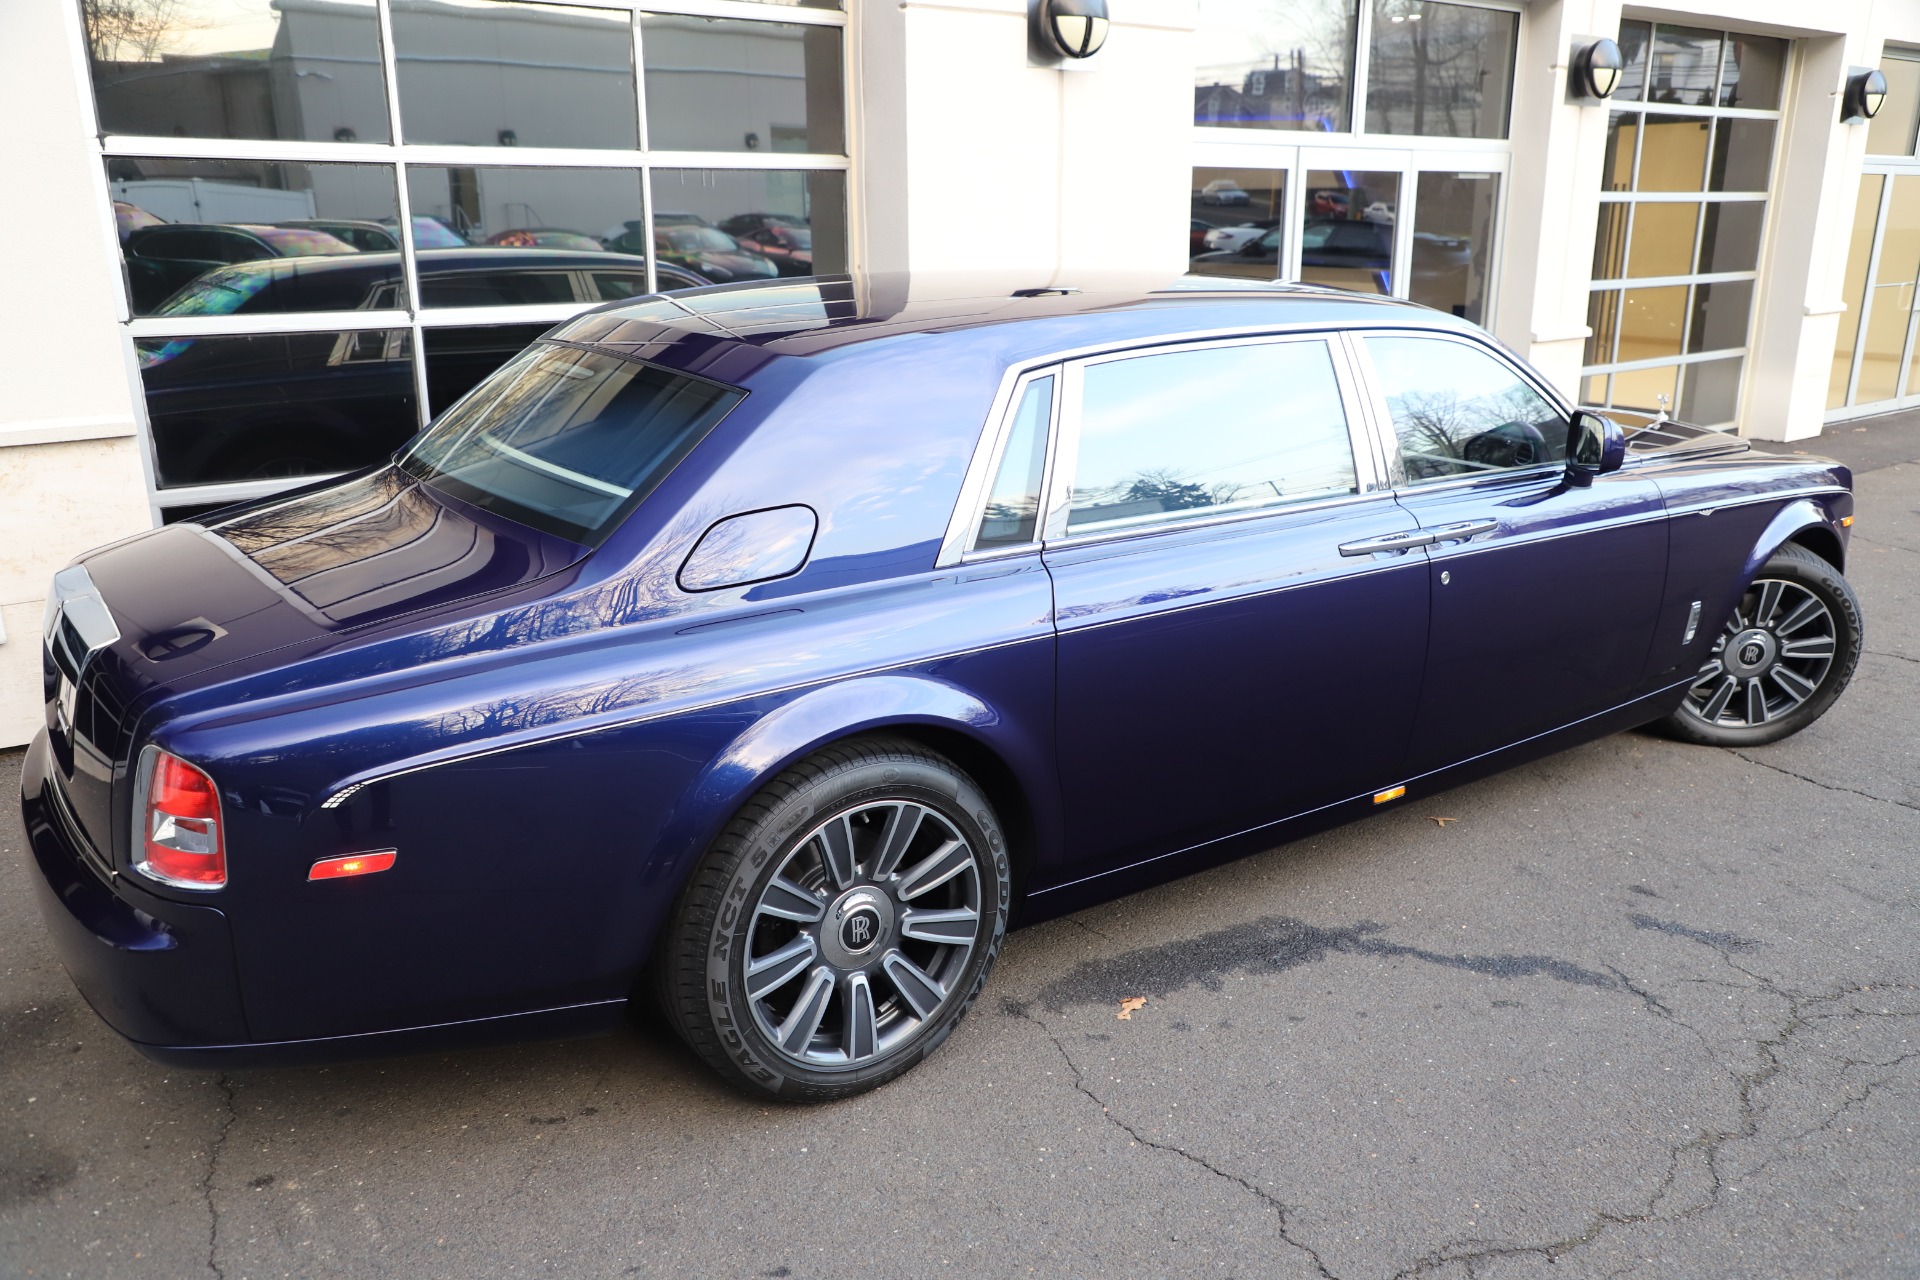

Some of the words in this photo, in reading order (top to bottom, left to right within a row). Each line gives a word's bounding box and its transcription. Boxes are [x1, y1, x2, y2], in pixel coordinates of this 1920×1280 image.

[1821, 577, 1859, 695] GOODYEAR
[750, 846, 769, 870] 5
[712, 876, 748, 962] NCT
[851, 915, 871, 943] RR
[948, 809, 1010, 1032] GOODYEAR
[711, 978, 778, 1083] EAGLE
